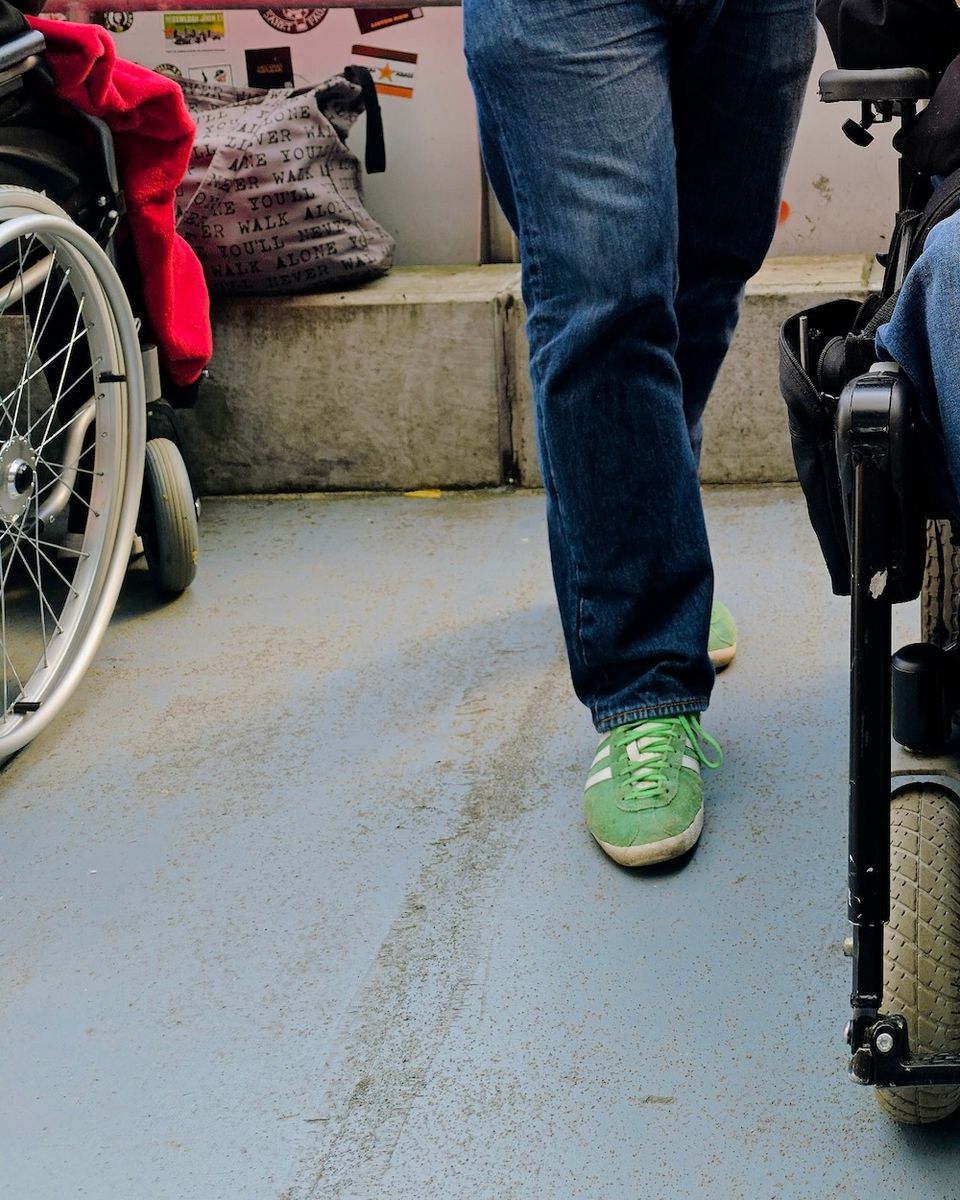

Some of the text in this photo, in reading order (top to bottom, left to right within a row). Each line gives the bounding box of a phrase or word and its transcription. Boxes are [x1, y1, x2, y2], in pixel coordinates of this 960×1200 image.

[238, 212, 290, 235] WALK
[217, 236, 284, 258] YOU'LL
[276, 242, 338, 269] ALONE
